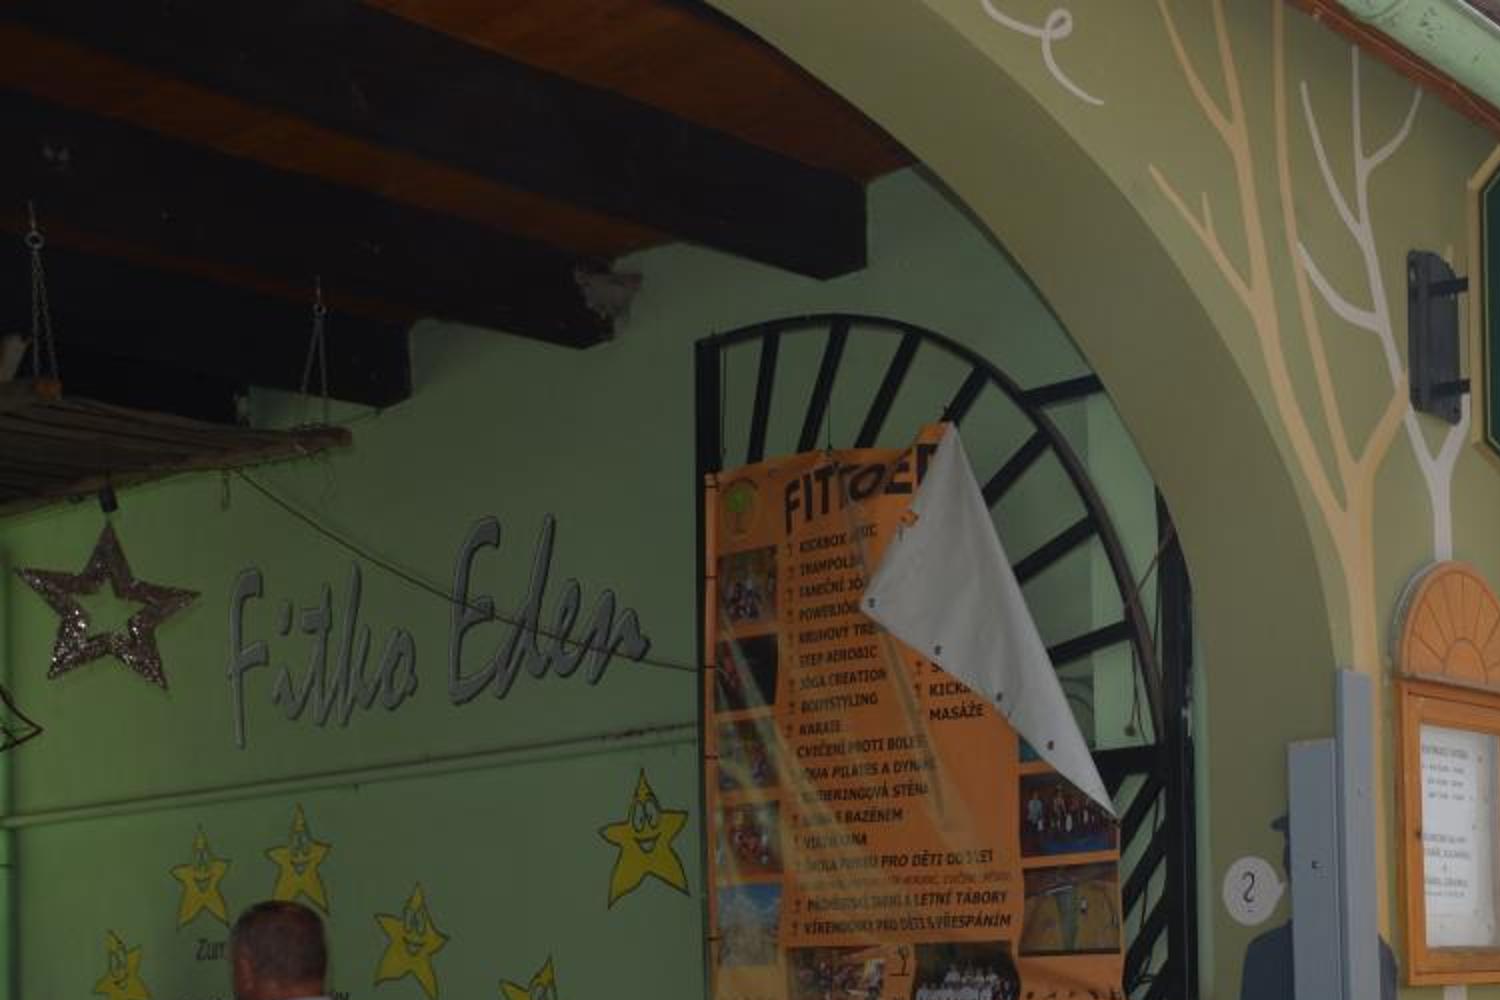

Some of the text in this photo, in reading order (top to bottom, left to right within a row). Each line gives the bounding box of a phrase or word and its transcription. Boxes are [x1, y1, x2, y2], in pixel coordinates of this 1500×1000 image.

[227, 513, 651, 750] Fitko Eden
[929, 702, 984, 721] MASÁŽE
[881, 853, 909, 869] PRO
[911, 850, 944, 868] DĚTI
[956, 887, 1009, 905] TÁBORY
